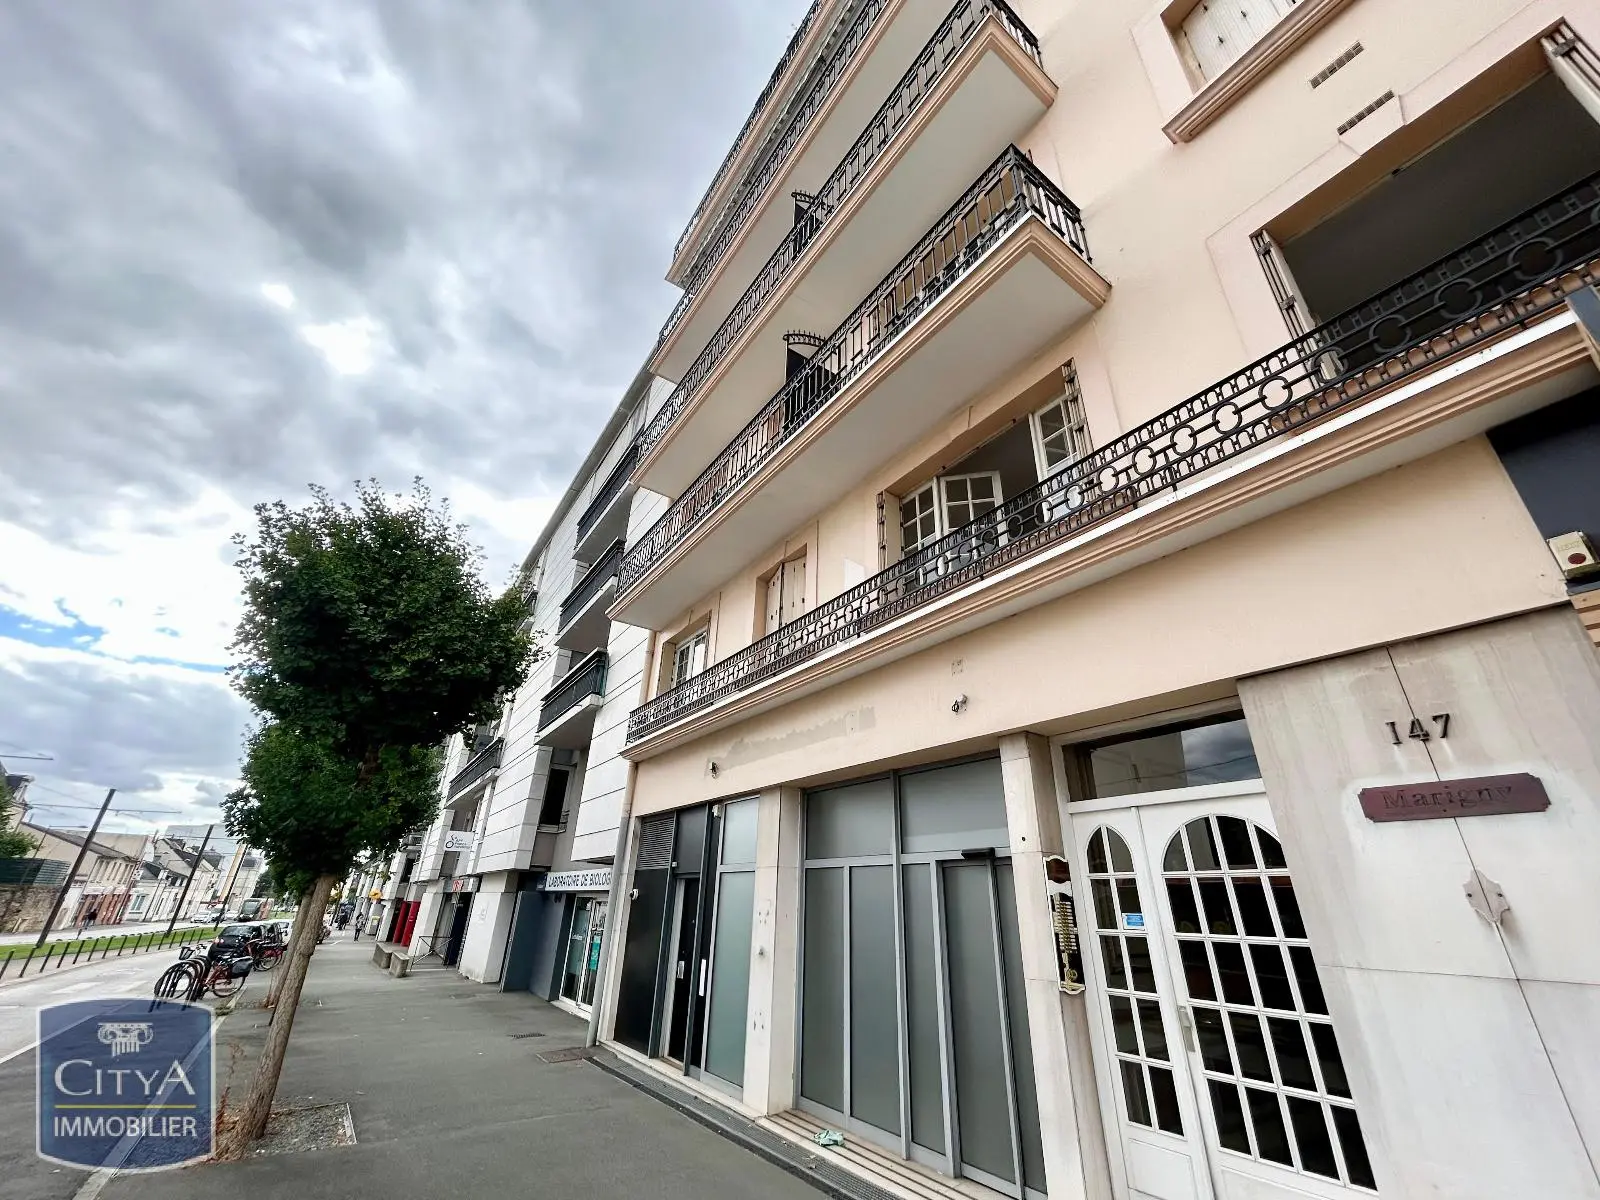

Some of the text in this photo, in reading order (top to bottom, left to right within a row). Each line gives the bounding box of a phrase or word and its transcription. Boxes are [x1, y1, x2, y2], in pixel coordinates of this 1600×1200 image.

[1385, 713, 1451, 745] 147
[1381, 784, 1513, 810] Marigny
[548, 874, 580, 887] LABORATOIRE
[581, 873, 588, 886] DE
